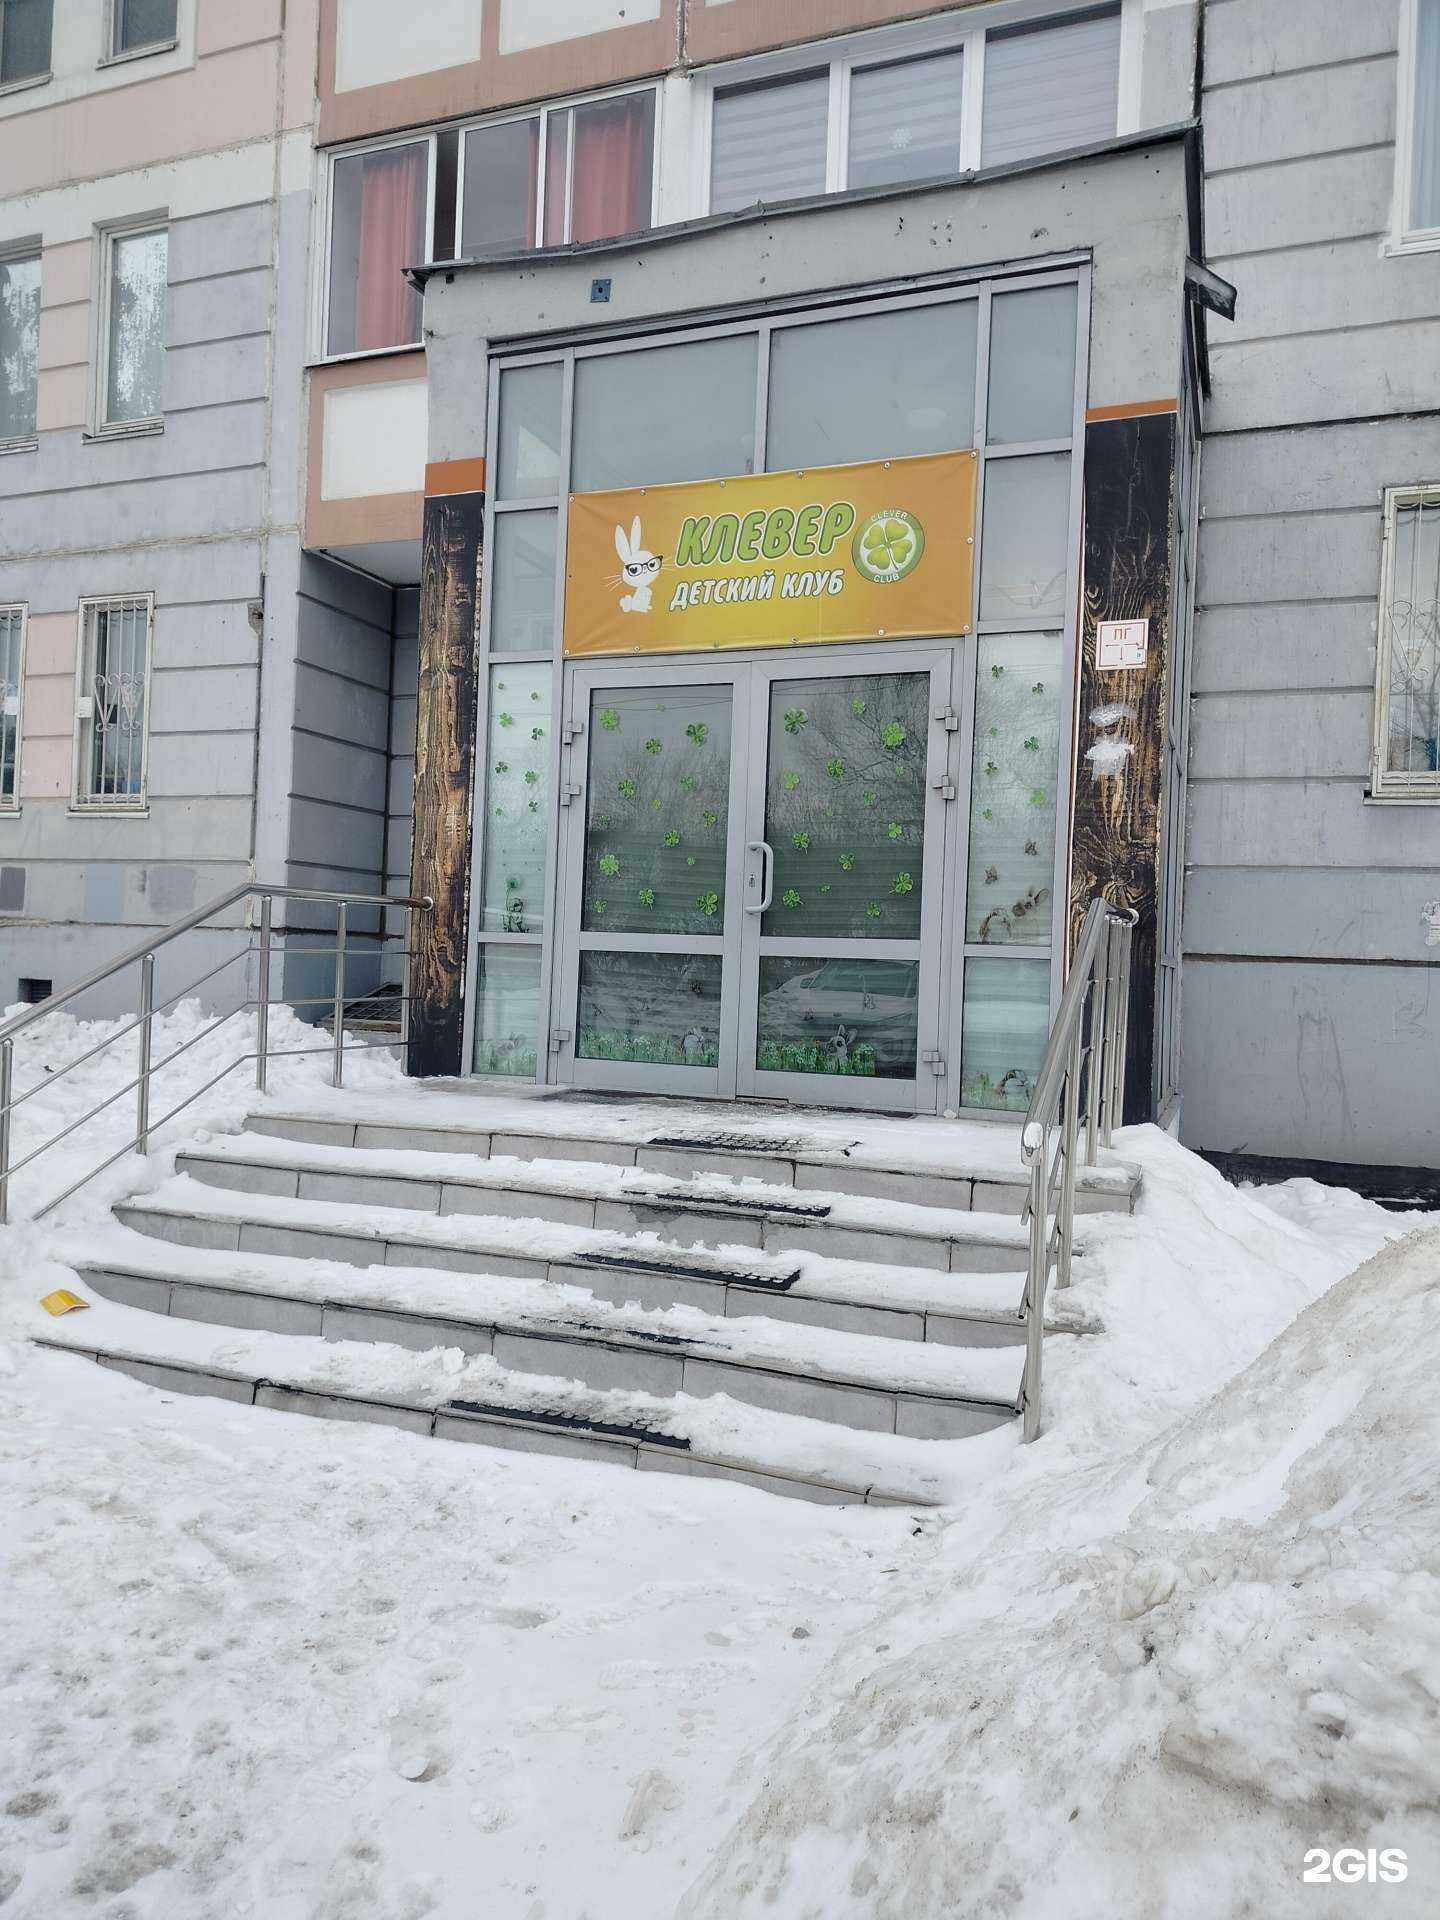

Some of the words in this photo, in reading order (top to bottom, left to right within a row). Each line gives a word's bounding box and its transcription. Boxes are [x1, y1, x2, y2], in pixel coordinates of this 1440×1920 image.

[870, 508, 908, 521] CLEVER
[675, 501, 856, 567] КЛЕВЕР
[873, 573, 900, 584] CLUB
[668, 568, 776, 612] ДЕТСКИЙ
[780, 568, 845, 599] КЛУБ
[1113, 627, 1132, 641] ПГ
